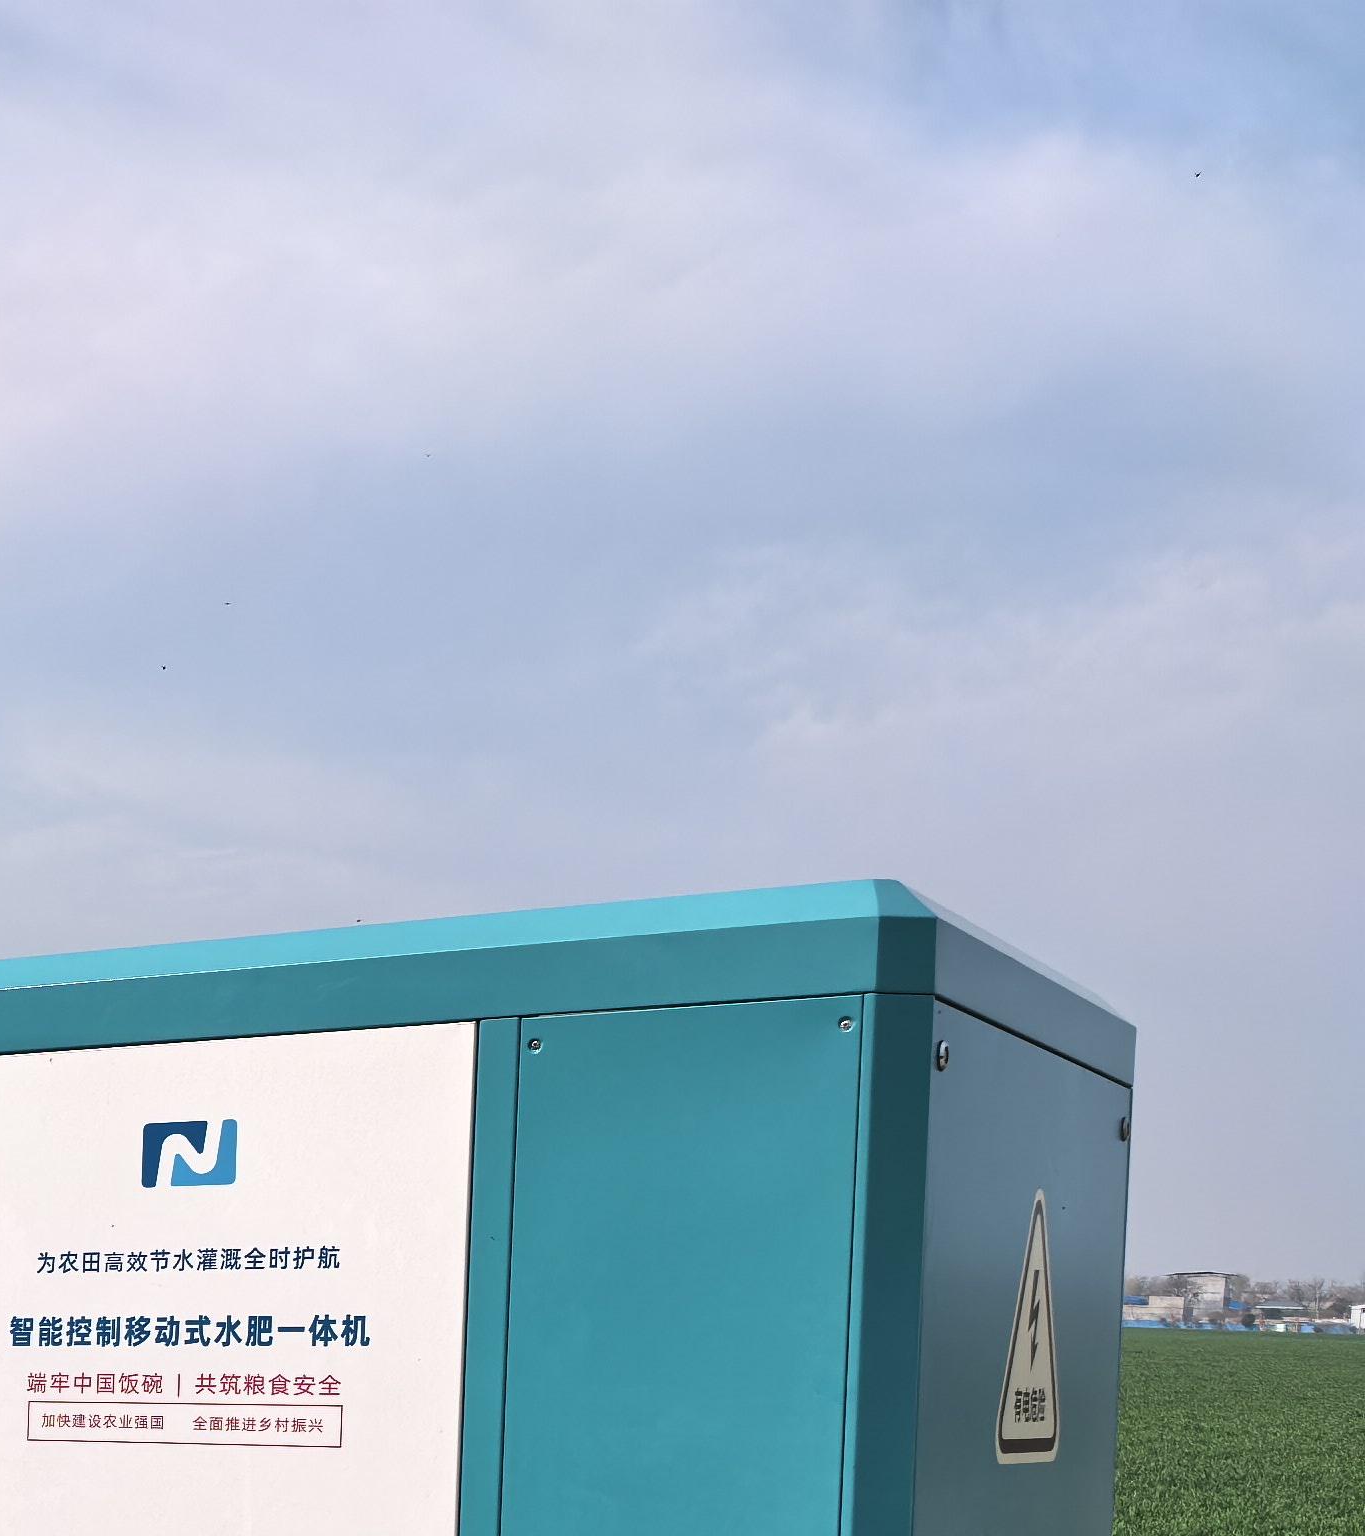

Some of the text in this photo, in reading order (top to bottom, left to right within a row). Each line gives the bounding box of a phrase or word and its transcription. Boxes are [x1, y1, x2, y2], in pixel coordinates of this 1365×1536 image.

[36, 1245, 341, 1274] 为农田高效节水灌溉全时护航
[9, 1314, 371, 1348] 智能控制移动式水肥一体机
[26, 1372, 342, 1396] 端牢中国饭碗 共筑粮食安全
[41, 1413, 324, 1433] 加快建设农业强国 全面推进乡村振兴
